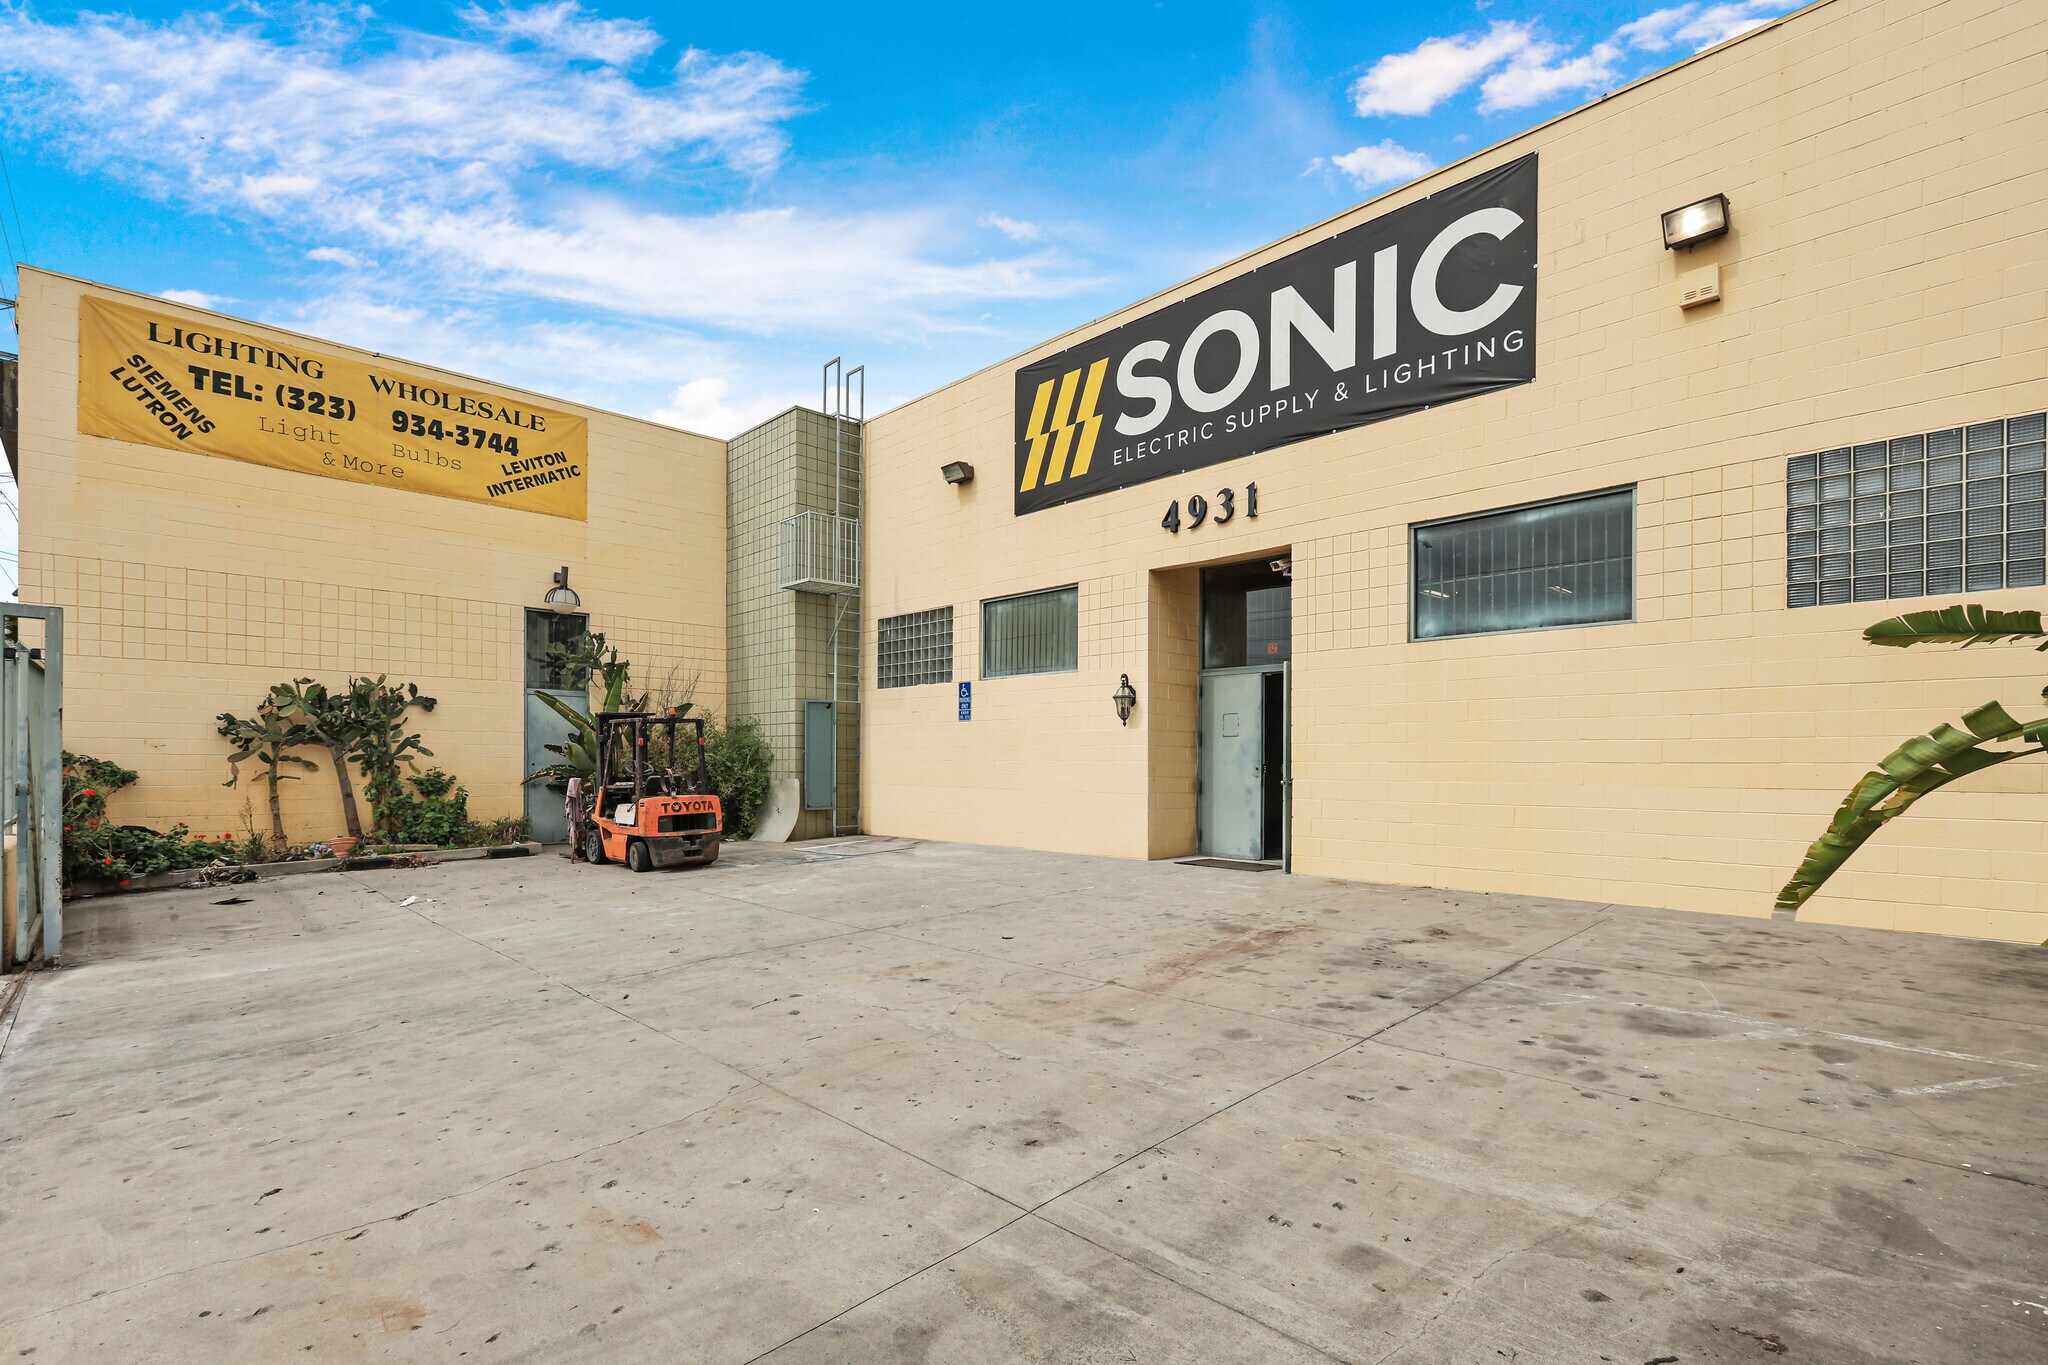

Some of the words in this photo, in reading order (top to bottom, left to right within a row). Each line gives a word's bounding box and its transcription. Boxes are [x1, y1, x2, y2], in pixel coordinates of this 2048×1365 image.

[1114, 207, 1525, 436] SONIC
[109, 366, 194, 440] LUTRON
[127, 354, 216, 434] SIEMENS
[147, 321, 325, 379] LIGHTING
[368, 374, 547, 432] WHOLESALE
[1113, 421, 1214, 466] ELECTRIC
[1225, 389, 1319, 433] SUPPLY
[1334, 381, 1349, 402] &
[1365, 330, 1525, 394] LIGHTING
[188, 364, 264, 402] TEL:
[275, 384, 357, 422] (323)
[391, 409, 520, 456] 934-3744
[258, 416, 341, 445] Light
[391, 443, 463, 471] Bulbs
[322, 451, 336, 467] &
[343, 454, 405, 478] More
[501, 451, 568, 477] LEVITON
[486, 464, 582, 498] INTERMATIC
[1161, 481, 1259, 535] 4931
[661, 800, 714, 813] TOYOTA
